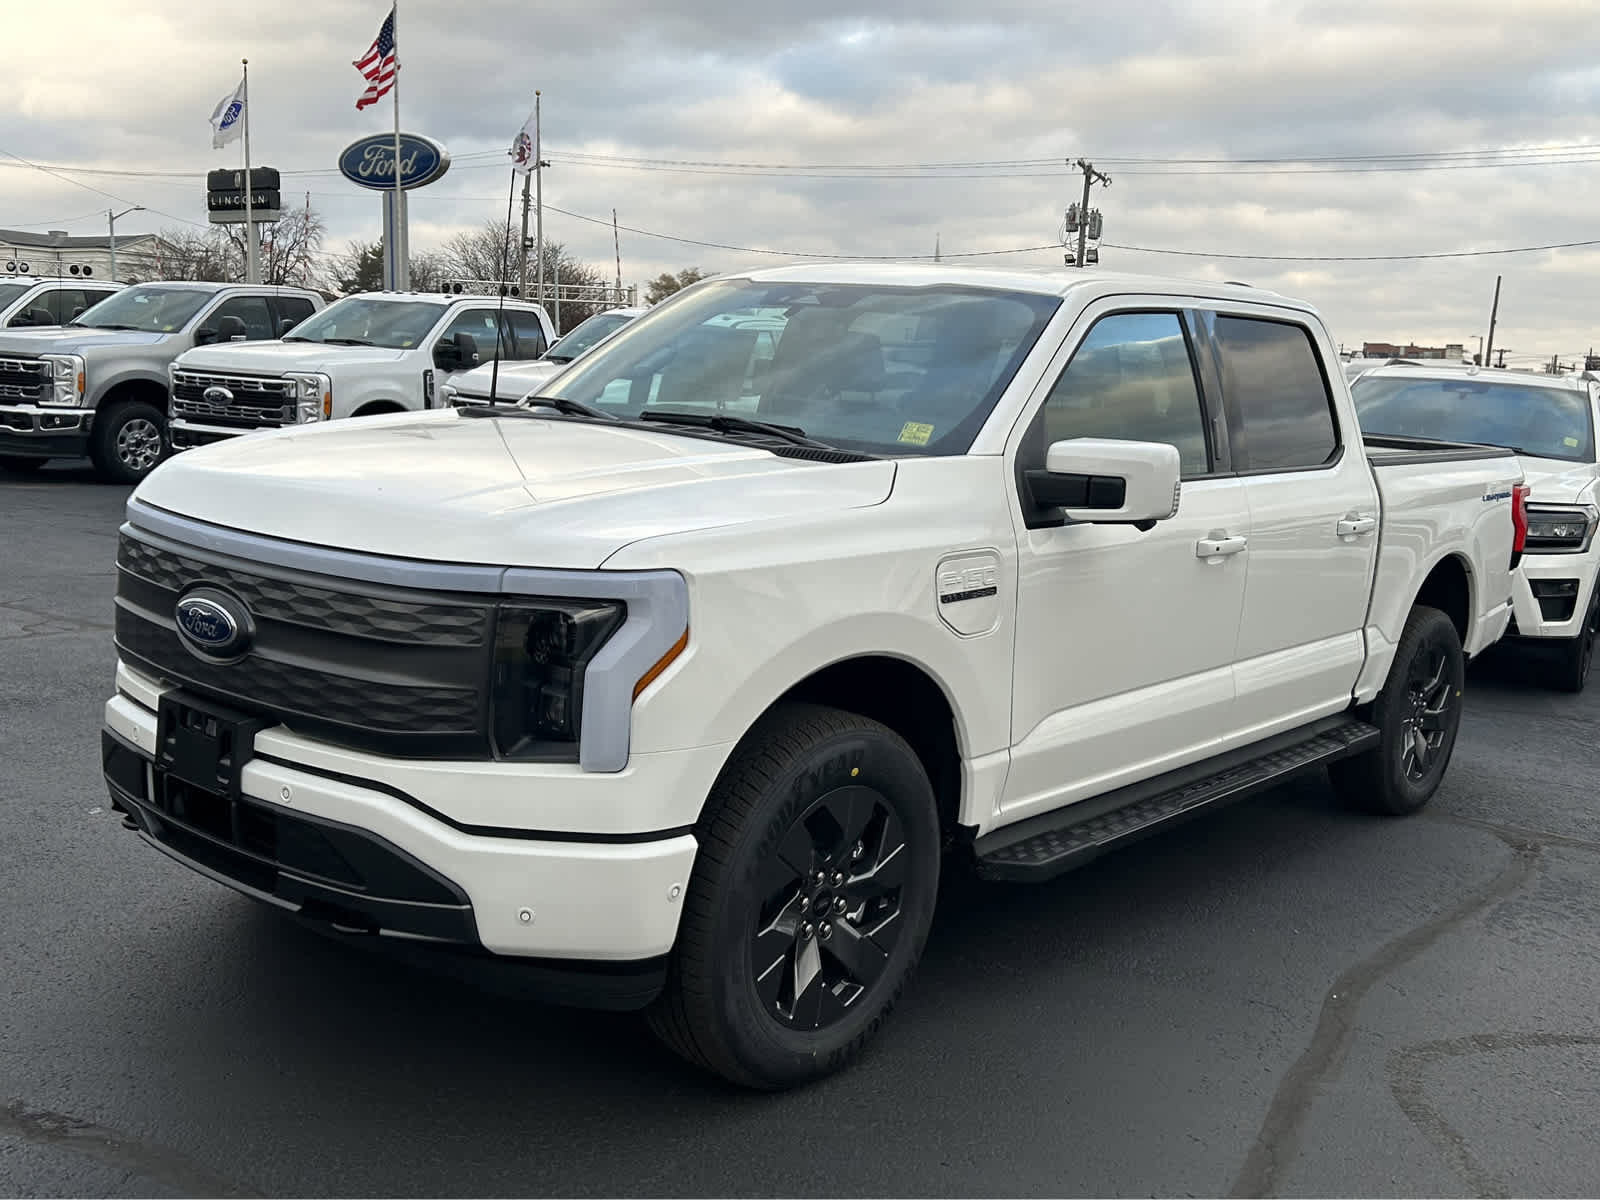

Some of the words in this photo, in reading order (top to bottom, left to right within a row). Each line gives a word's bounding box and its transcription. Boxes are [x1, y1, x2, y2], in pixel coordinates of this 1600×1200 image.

[358, 145, 418, 177] Ford
[211, 195, 265, 206] LINCOLN
[185, 607, 219, 637] Ford
